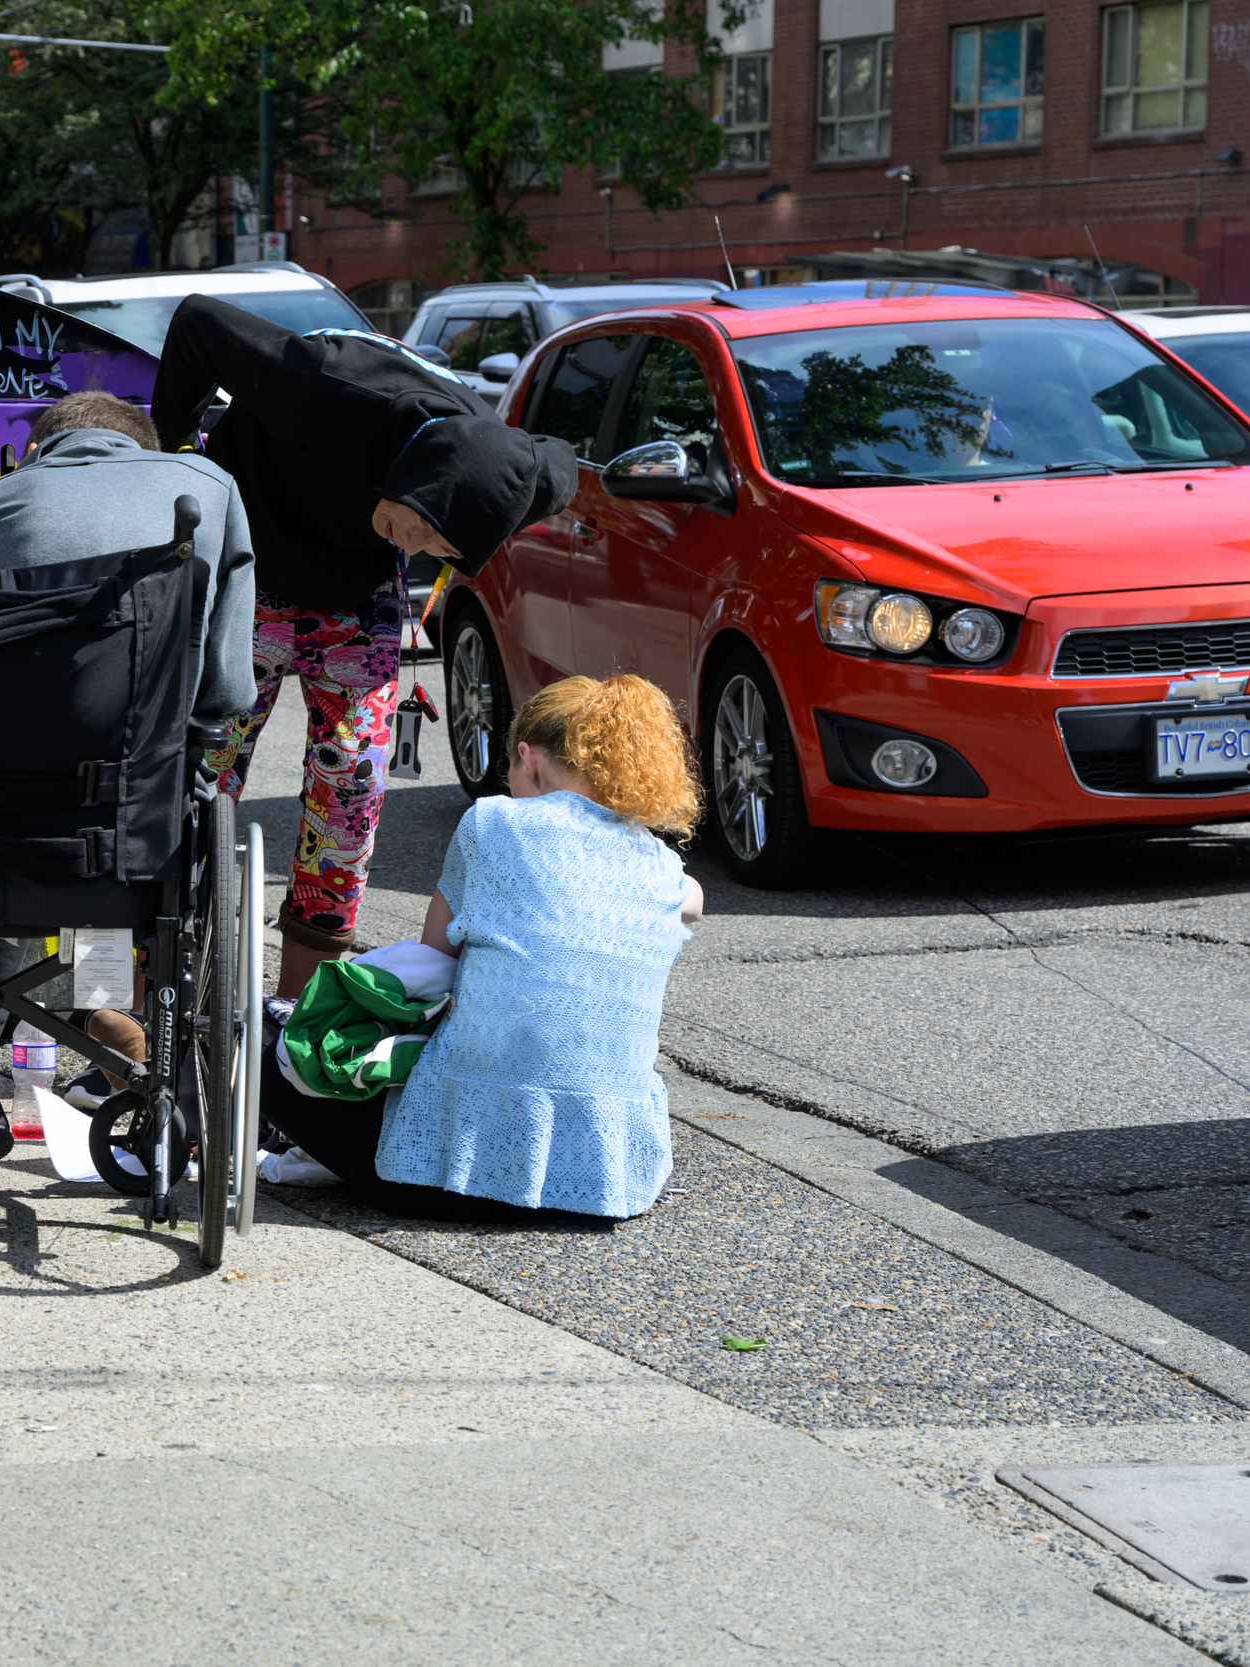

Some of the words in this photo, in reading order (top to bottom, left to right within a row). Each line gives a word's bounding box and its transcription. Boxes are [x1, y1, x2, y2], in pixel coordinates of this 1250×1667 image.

[15, 309, 65, 361] MY
[1164, 722, 1198, 732] Beautiful
[1200, 720, 1225, 731] British
[1158, 731, 1207, 764] TV7
[157, 1008, 165, 1075] COMPOSITES
